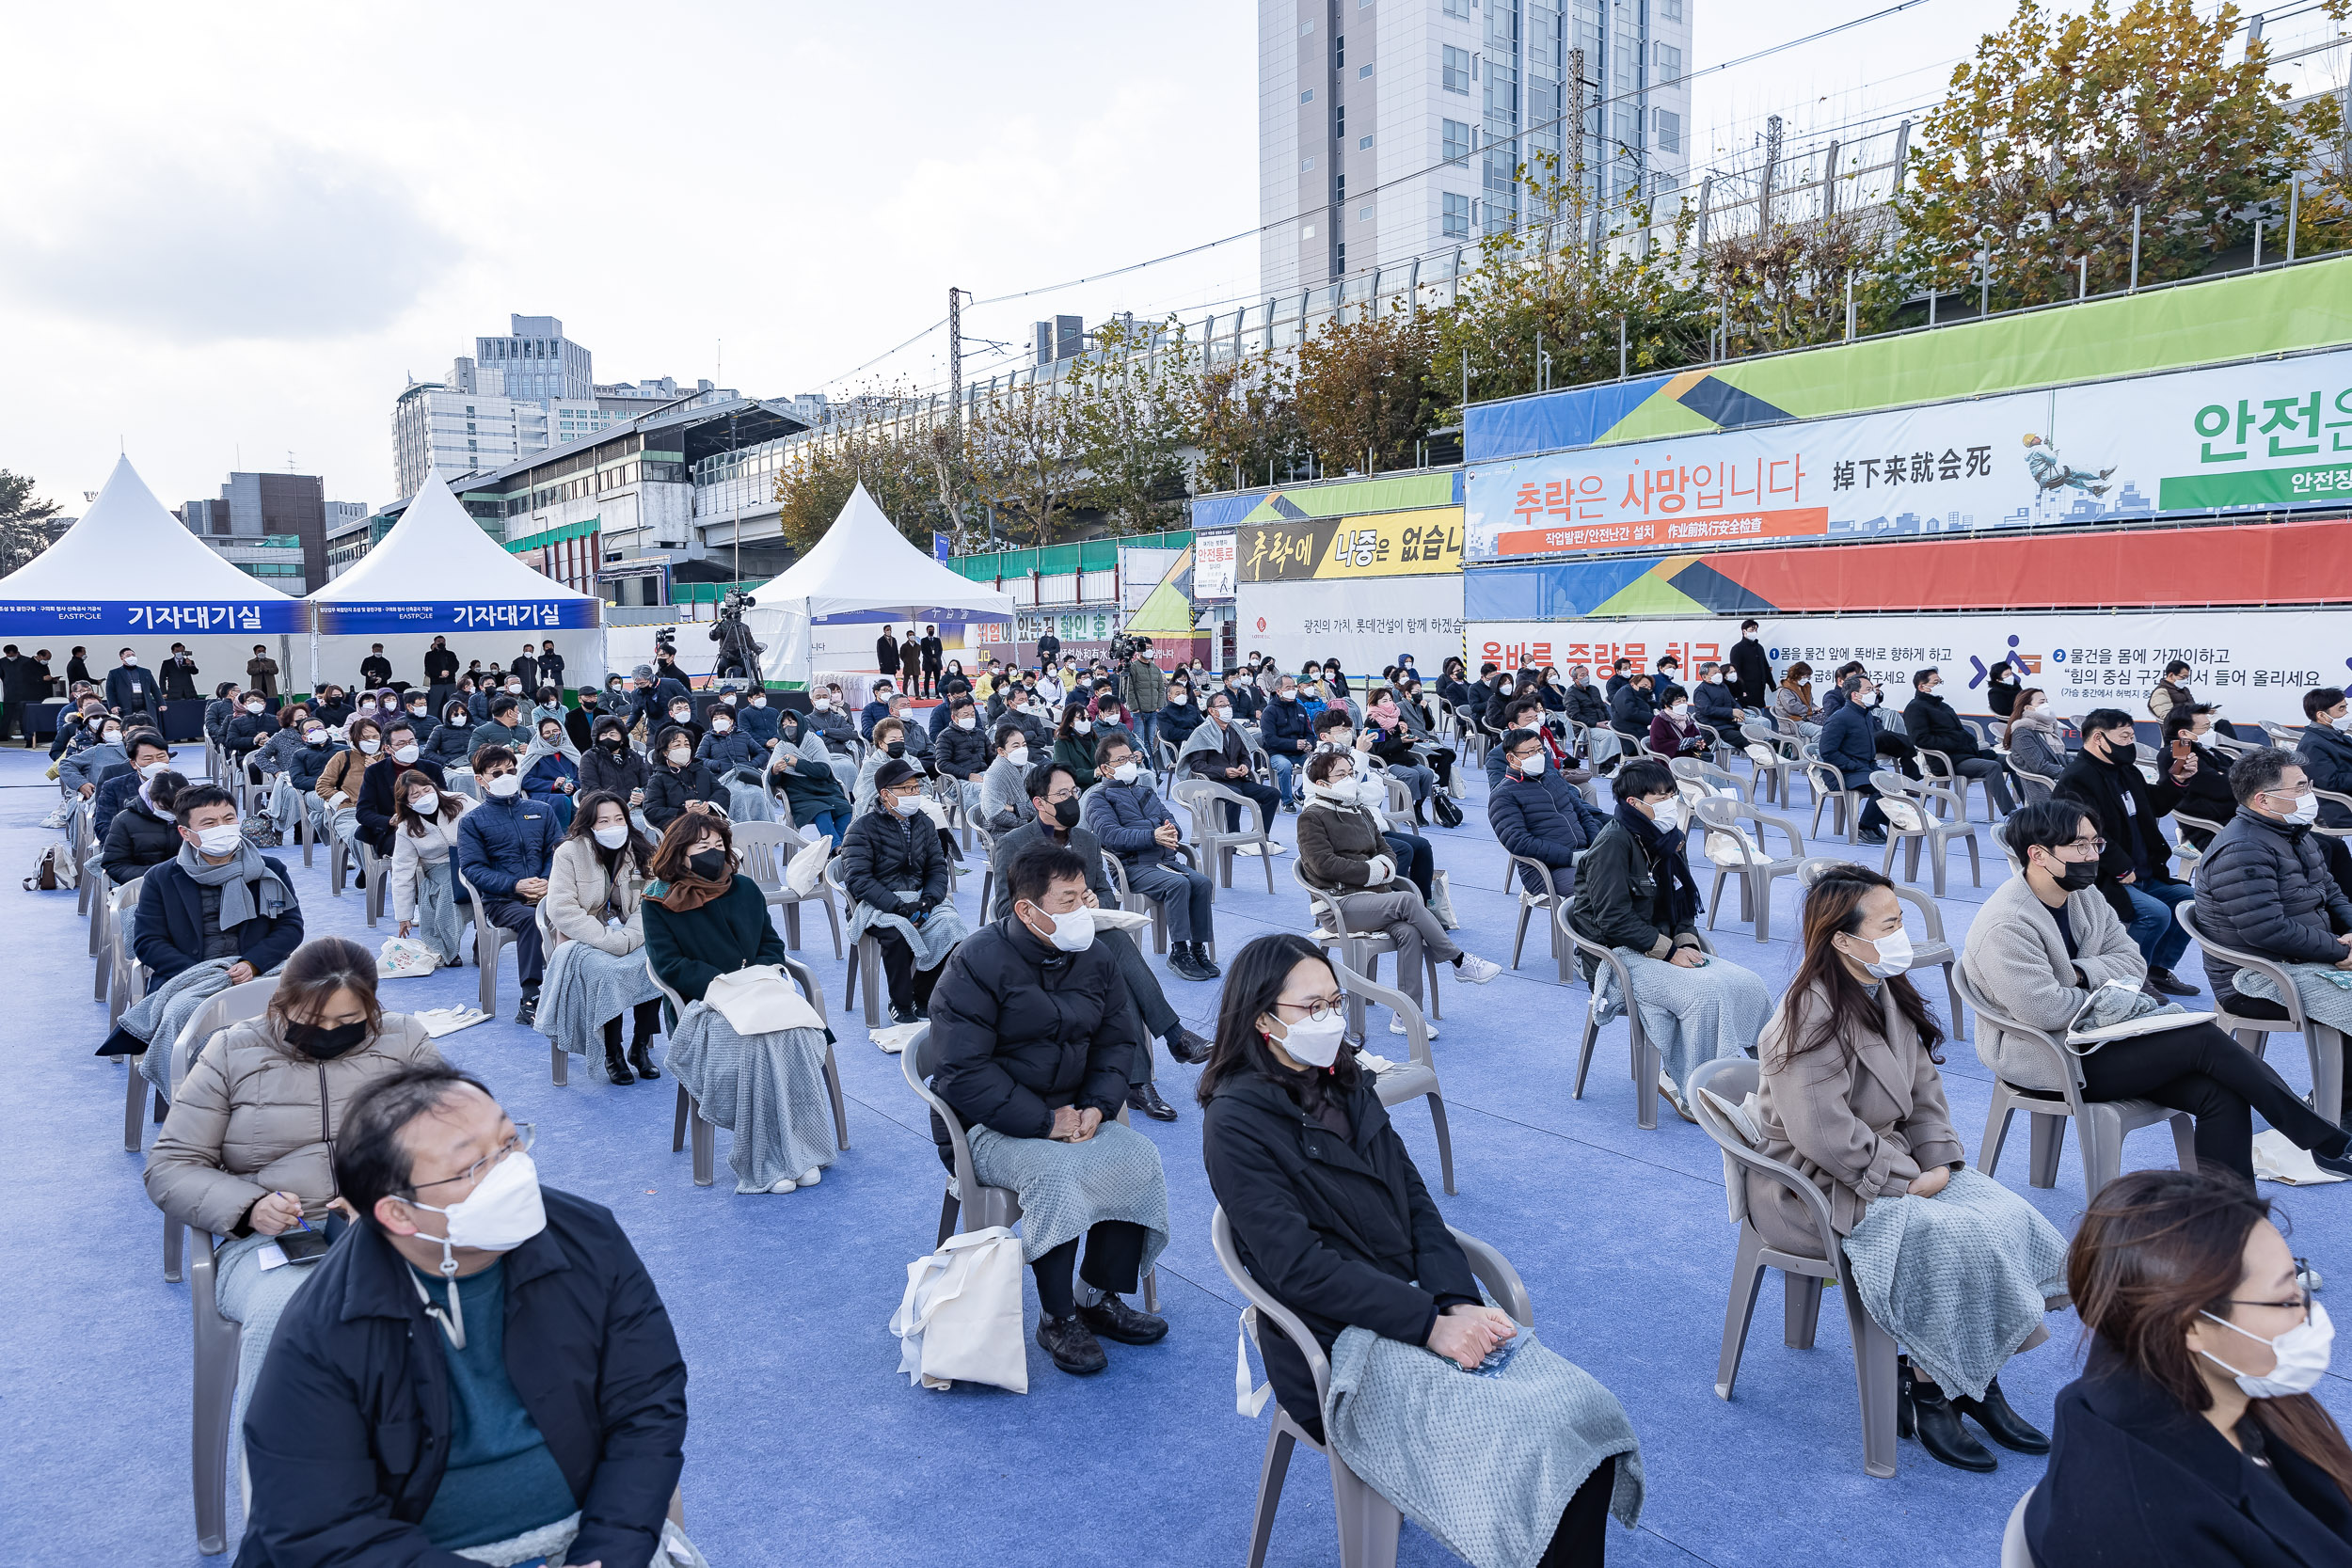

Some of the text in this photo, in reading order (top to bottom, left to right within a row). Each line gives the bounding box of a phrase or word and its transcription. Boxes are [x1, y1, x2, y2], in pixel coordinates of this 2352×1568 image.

[1834, 445, 1992, 491] 掉下来就会死
[1515, 453, 1805, 525] 추락은 사망입니다
[1546, 527, 1655, 546] 작업발판/안전난간 설치
[1668, 517, 1762, 538] 作业前执行安全检查
[1198, 547, 1234, 562] 안전통로
[1247, 531, 1313, 580] 추락에
[1335, 530, 1390, 567] 나중은
[58, 612, 102, 621] EASTPOLE
[128, 606, 262, 629] 기자대기실
[399, 612, 433, 621] EASTPOLE
[453, 604, 561, 627] 기자대기실
[1060, 614, 1088, 640] 확인
[1093, 613, 1106, 639] 후
[1304, 619, 1330, 633] 광진의
[1333, 618, 1353, 634] 가치,
[1356, 618, 1403, 634] 롯데건설이
[1406, 618, 1426, 633] 함께
[1781, 647, 1802, 660] 몸을
[1804, 647, 1825, 660] 물건
[1829, 647, 1850, 660] 앞에
[1854, 647, 1887, 661] 똑바로
[1891, 647, 1925, 661] 향하게
[1929, 648, 1952, 661] 하고
[2070, 648, 2112, 664] 물건을
[2118, 648, 2147, 664] 몸에
[2153, 648, 2231, 665] 가까이하고
[2103, 669, 2131, 685] 중심
[2214, 670, 2247, 686] 들어
[2252, 670, 2321, 687] 올리세요
[2082, 689, 2113, 698] 중간에서
[2116, 689, 2139, 698] 허벅지
